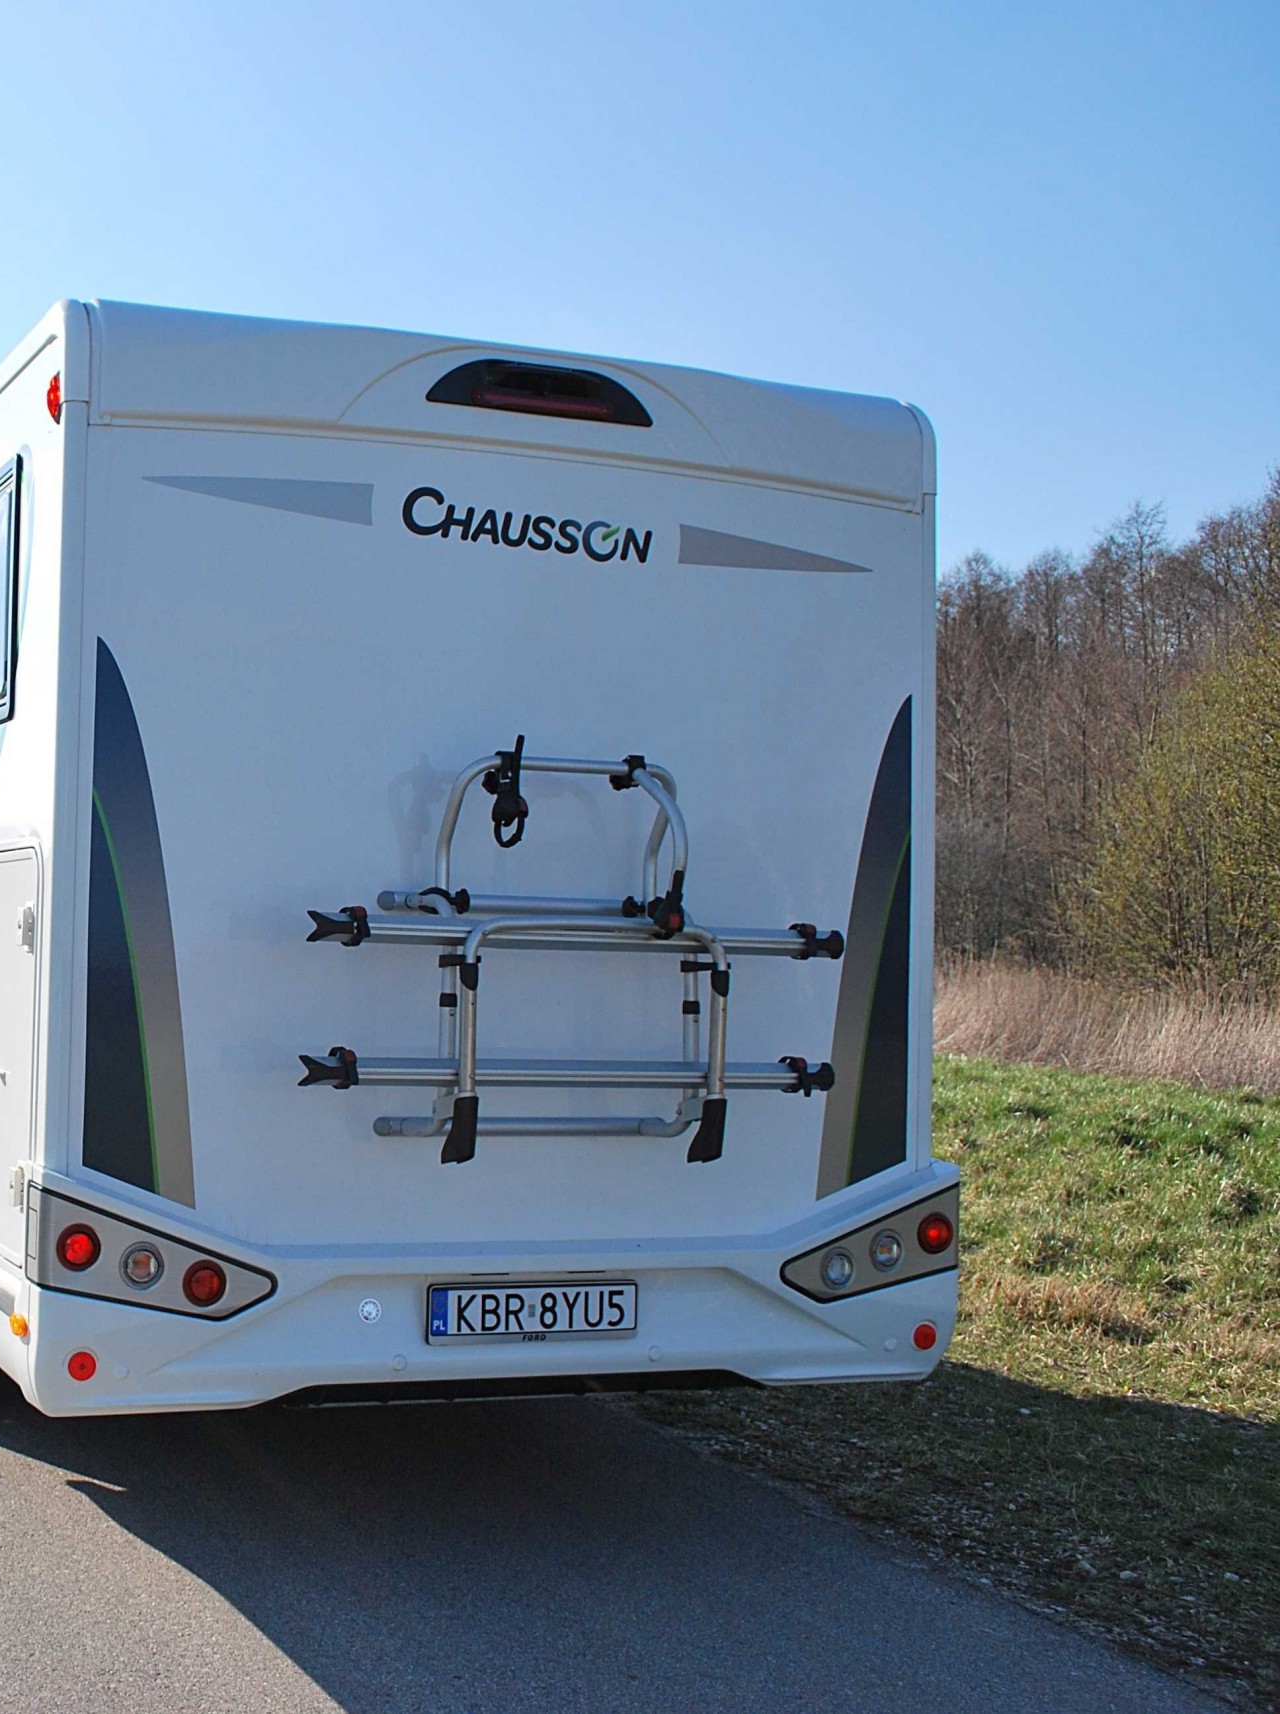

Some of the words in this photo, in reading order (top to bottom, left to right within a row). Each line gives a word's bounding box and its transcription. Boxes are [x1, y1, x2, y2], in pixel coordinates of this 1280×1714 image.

[402, 486, 653, 564] CHAUSSON
[433, 1320, 446, 1331] PL
[456, 1293, 524, 1332] KBR
[540, 1289, 625, 1329] 8YU5
